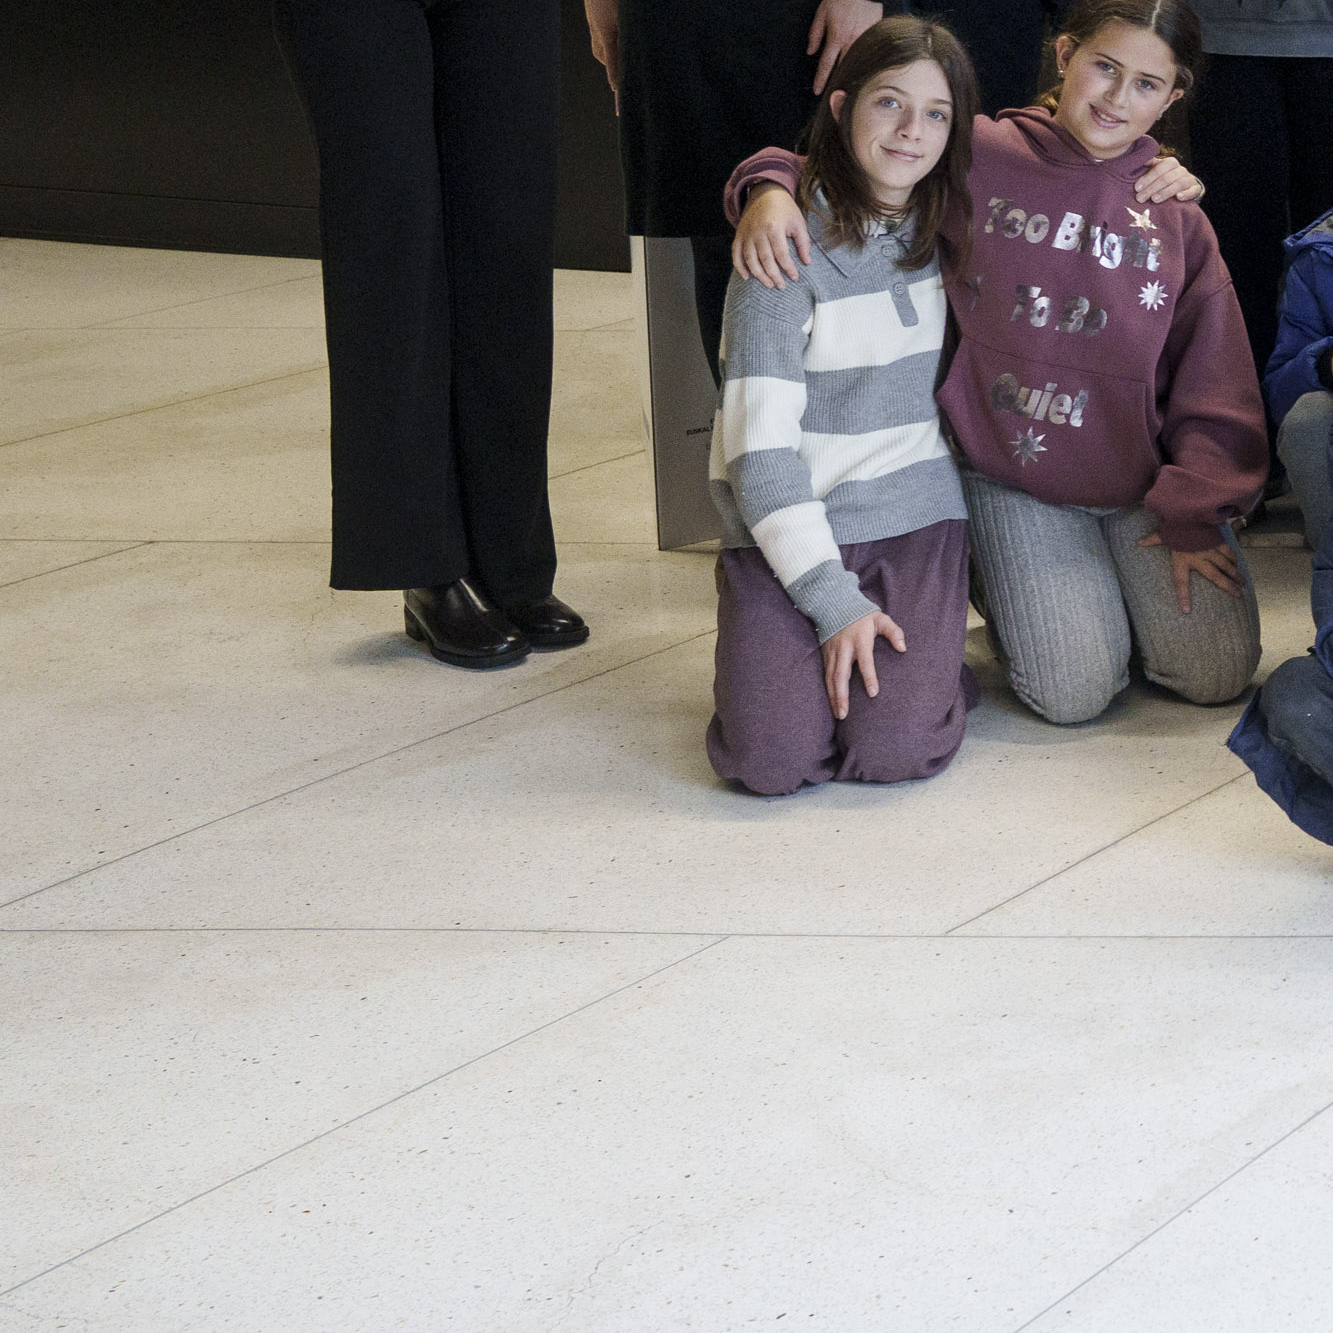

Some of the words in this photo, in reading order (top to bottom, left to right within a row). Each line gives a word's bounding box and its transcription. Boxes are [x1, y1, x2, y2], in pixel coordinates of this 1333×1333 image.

[984, 196, 1050, 244] Too
[1052, 211, 1163, 272] Bright
[1011, 284, 1051, 328] To
[1055, 295, 1108, 338] Be
[991, 372, 1090, 427] Quiet
